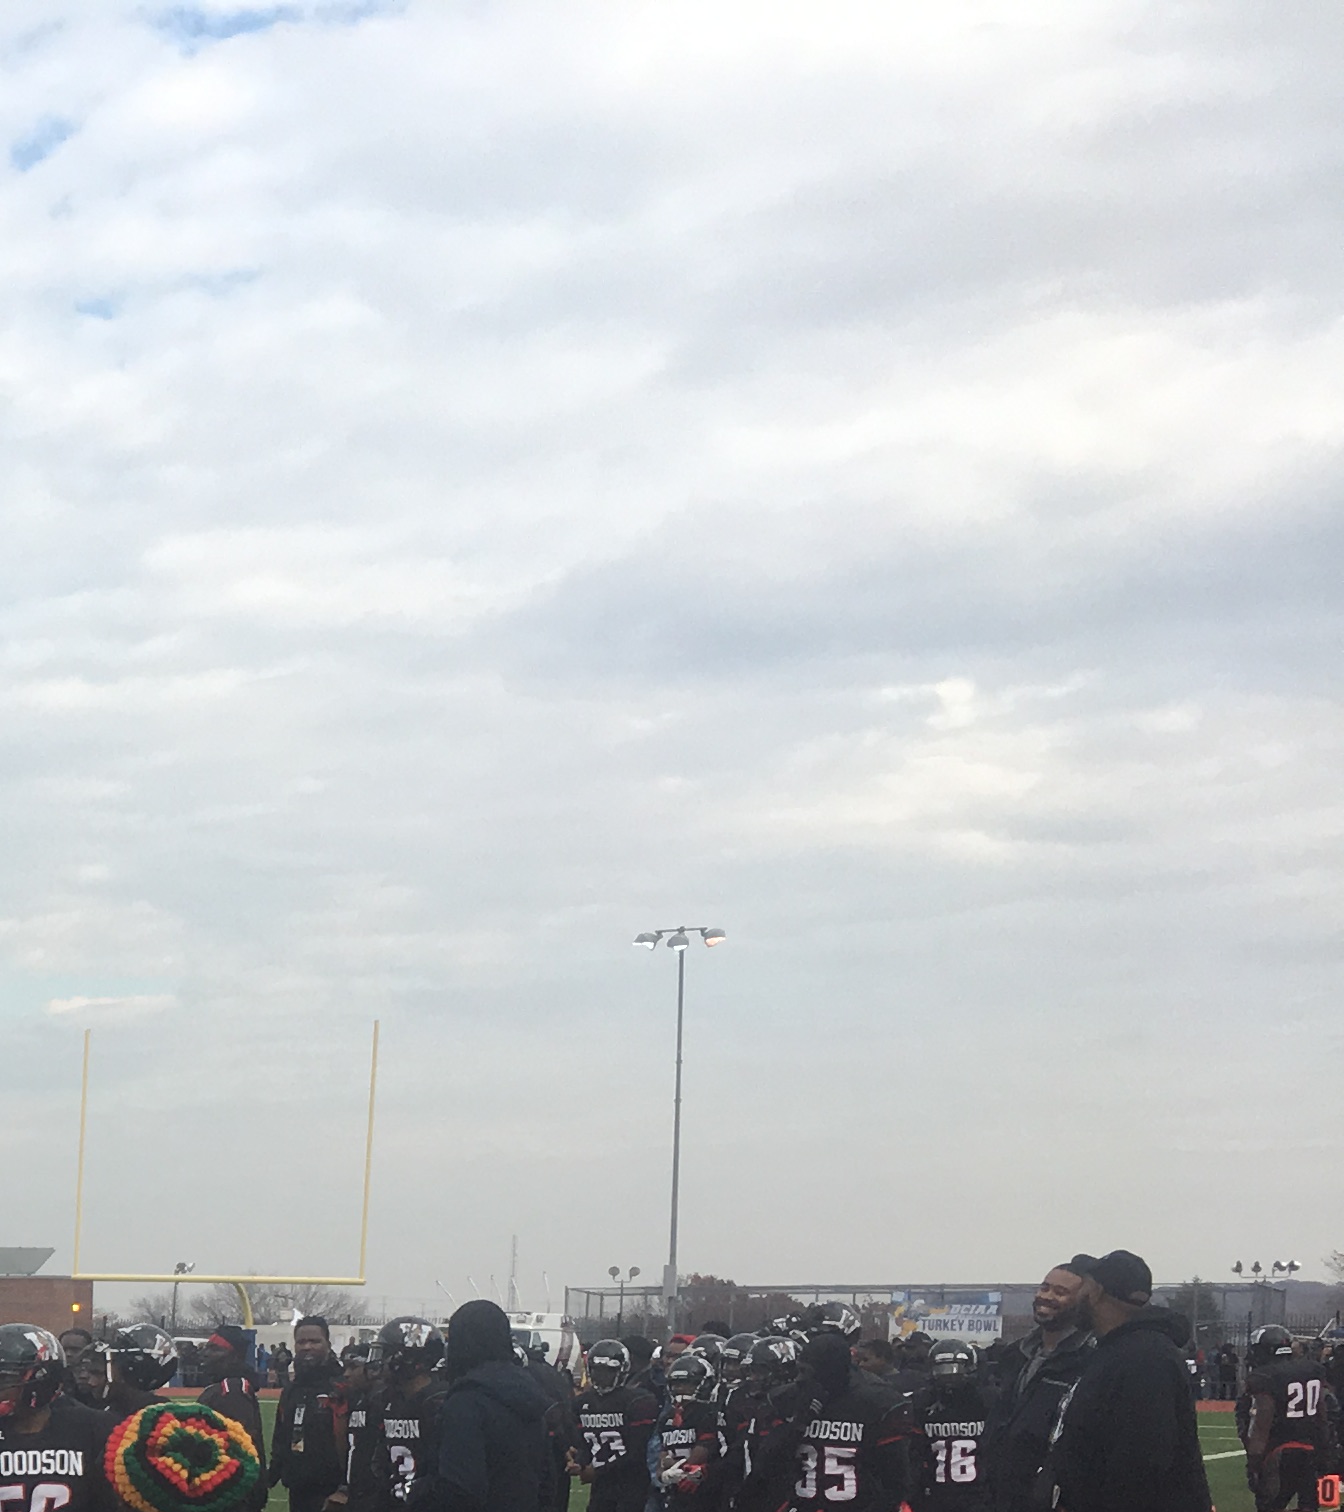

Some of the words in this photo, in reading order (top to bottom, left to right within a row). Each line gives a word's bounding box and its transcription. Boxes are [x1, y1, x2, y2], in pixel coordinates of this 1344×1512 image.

[921, 1319, 965, 1332] TURKEY
[967, 1319, 1000, 1333] BOWL
[1286, 1379, 1321, 1418] 20
[804, 1419, 864, 1442] ODSON
[931, 1439, 977, 1483] 16
